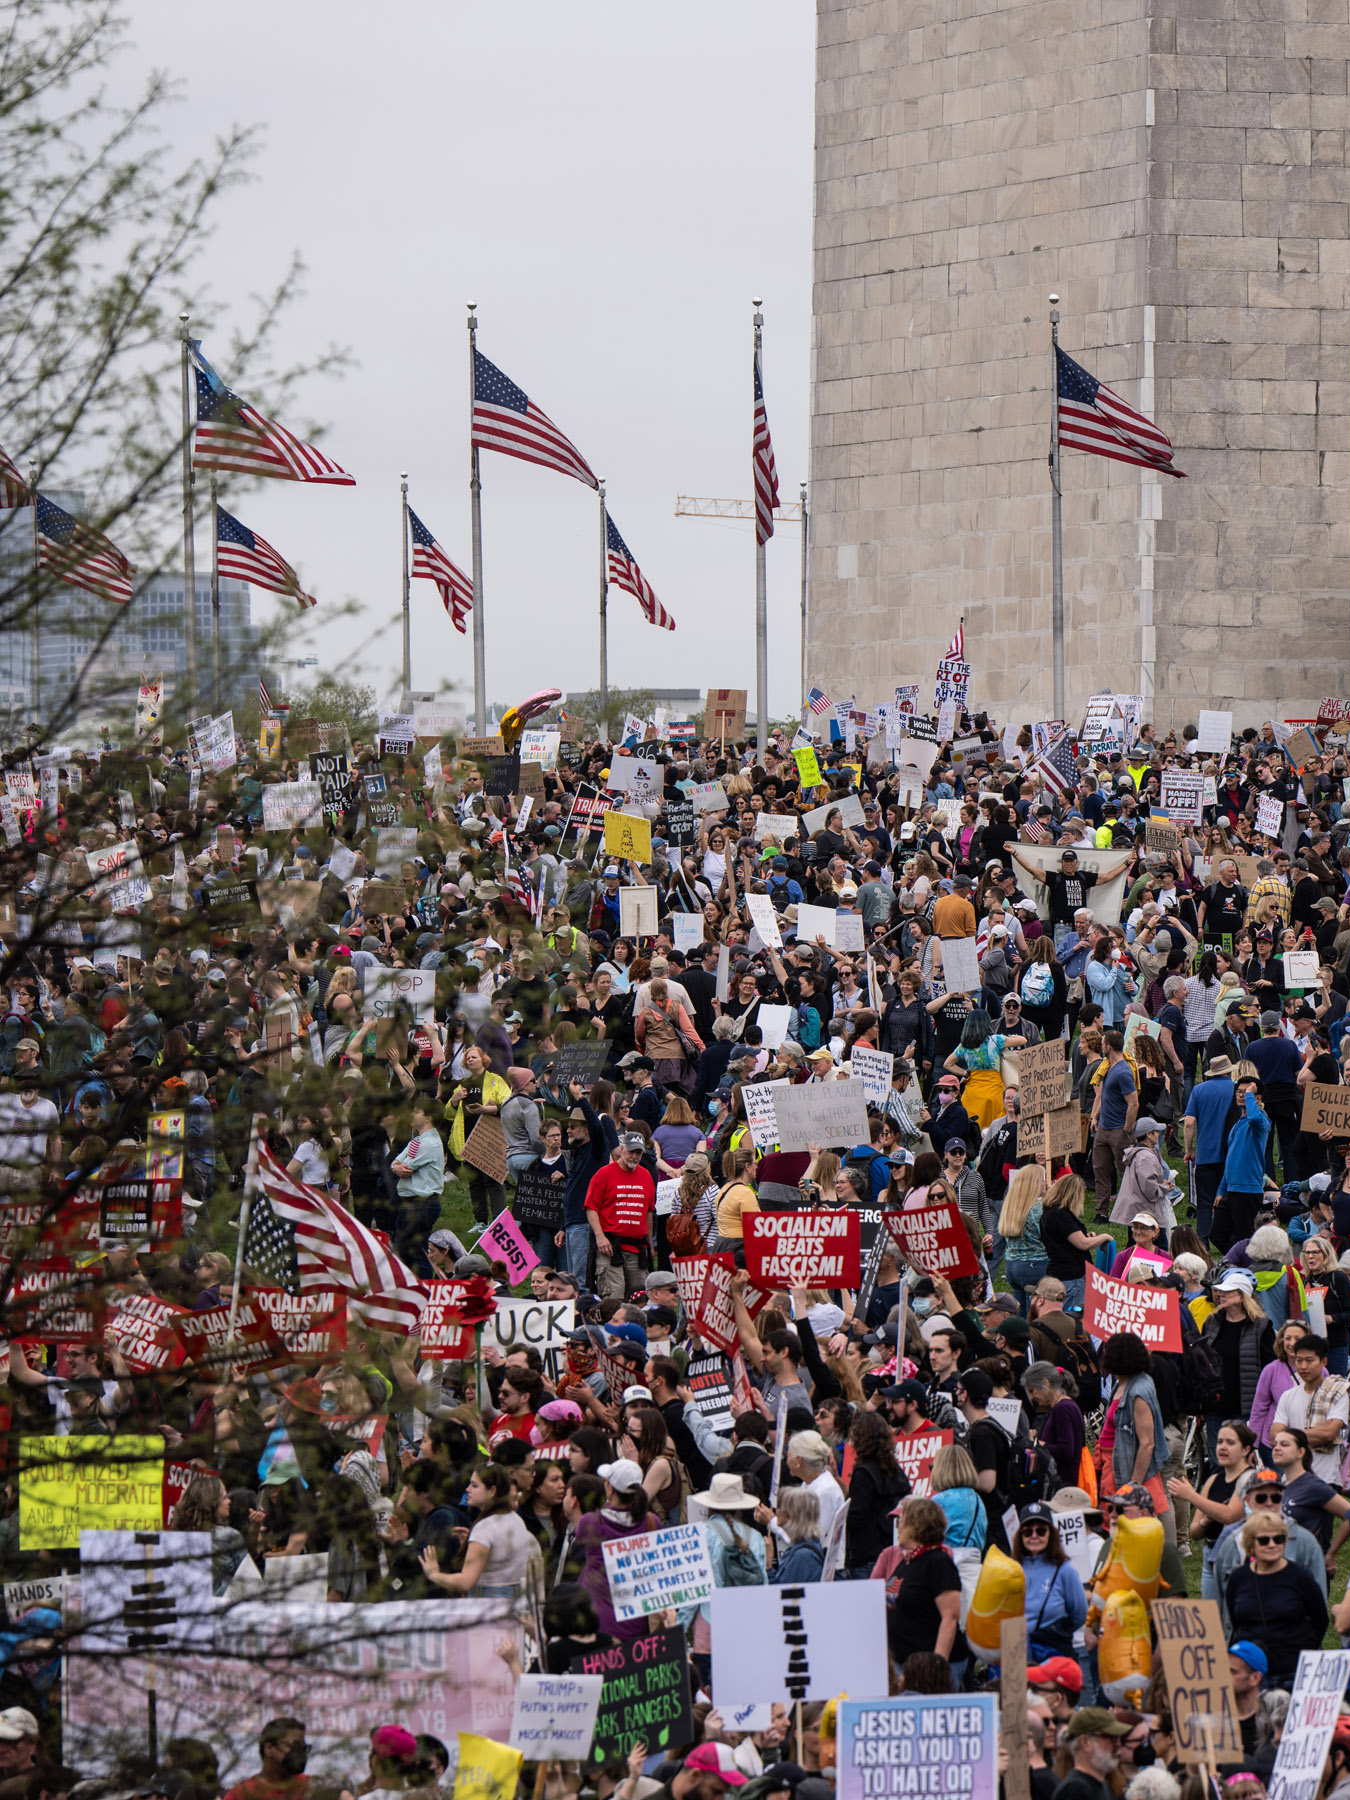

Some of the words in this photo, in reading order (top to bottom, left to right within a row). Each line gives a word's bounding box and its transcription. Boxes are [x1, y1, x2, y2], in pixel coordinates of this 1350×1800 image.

[939, 661, 955, 671] LET
[956, 663, 971, 674] THE
[936, 670, 970, 684] RIOT
[935, 688, 966, 699] RHYME
[940, 682, 950, 690] BE
[954, 684, 968, 692] THE
[1320, 698, 1343, 709] SAVE
[384, 717, 410, 726] RESIST
[632, 719, 641, 730] NO
[913, 721, 935, 733] HONK
[525, 734, 547, 743] FIGHT
[317, 756, 343, 772] NOT
[1167, 796, 1197, 809] OFF!
[1260, 797, 1281, 811] REMOVE
[391, 989, 408, 1001] the
[1020, 1051, 1036, 1071] STOP
[1037, 1044, 1064, 1062] TARIFFS
[1021, 1072, 1032, 1086] STOP
[1033, 1068, 1055, 1082] PROJECT
[745, 1087, 763, 1100] Did
[773, 1088, 791, 1100] GOT
[795, 1088, 814, 1100] THE
[1022, 1088, 1036, 1105] STOP
[787, 1111, 800, 1122] ME
[807, 1107, 853, 1122] NEITHER
[1021, 1105, 1038, 1119] DUMP
[782, 1130, 821, 1143] THANKS
[824, 1124, 865, 1139] SCIENCE!
[522, 1173, 535, 1183] YOU
[107, 1183, 147, 1199] UNION
[518, 1185, 535, 1196] HAVE
[516, 1195, 547, 1206] INSTEAD
[521, 1206, 559, 1222] FEMALE?
[887, 1209, 953, 1235] SOCIALISM
[105, 1223, 147, 1233] FREEDOM
[753, 1215, 848, 1237] SOCIALISM
[488, 1221, 528, 1272] RESIST
[776, 1238, 825, 1255] BEATS
[905, 1232, 939, 1252] BEATS
[761, 1255, 844, 1277] FASCISM!
[905, 1246, 961, 1271] FASCISM!
[1091, 1271, 1168, 1310] SOCIALISM
[1105, 1299, 1146, 1323] BEATS
[112, 1310, 160, 1341] BEATS
[271, 1313, 311, 1331] BEATS
[702, 1303, 738, 1343] FASCISM!
[688, 1356, 722, 1376] UNION
[688, 1371, 726, 1390] HOTTIE
[75, 1482, 159, 1505] MODERATE
[27, 1507, 53, 1524] AND
[656, 1525, 700, 1545] AMERICA
[616, 1557, 631, 1569] NO
[634, 1551, 660, 1565] LAWS
[661, 1546, 678, 1558] FOR
[681, 1539, 700, 1552] HIM
[613, 1572, 626, 1584] NO
[631, 1563, 665, 1579] RIGHTS
[667, 1558, 683, 1570] FOR
[685, 1553, 703, 1564] YOU
[8, 1583, 53, 1603] HANDS
[633, 1582, 654, 1597] ALL
[619, 1605, 635, 1617] TO
[1154, 1602, 1207, 1640] HANDS
[583, 1646, 625, 1675] HANDS
[1180, 1644, 1217, 1681] OFF
[645, 1660, 681, 1688] PARKS
[853, 1709, 916, 1739] JESUS
[920, 1706, 983, 1736] NEVER
[551, 1728, 585, 1740] MASCOT
[853, 1739, 913, 1766] ASKED
[917, 1737, 954, 1762] YOU
[957, 1735, 983, 1761] TO
[862, 1765, 887, 1794] TO
[892, 1764, 941, 1793] HATE
[945, 1763, 974, 1790] OR
